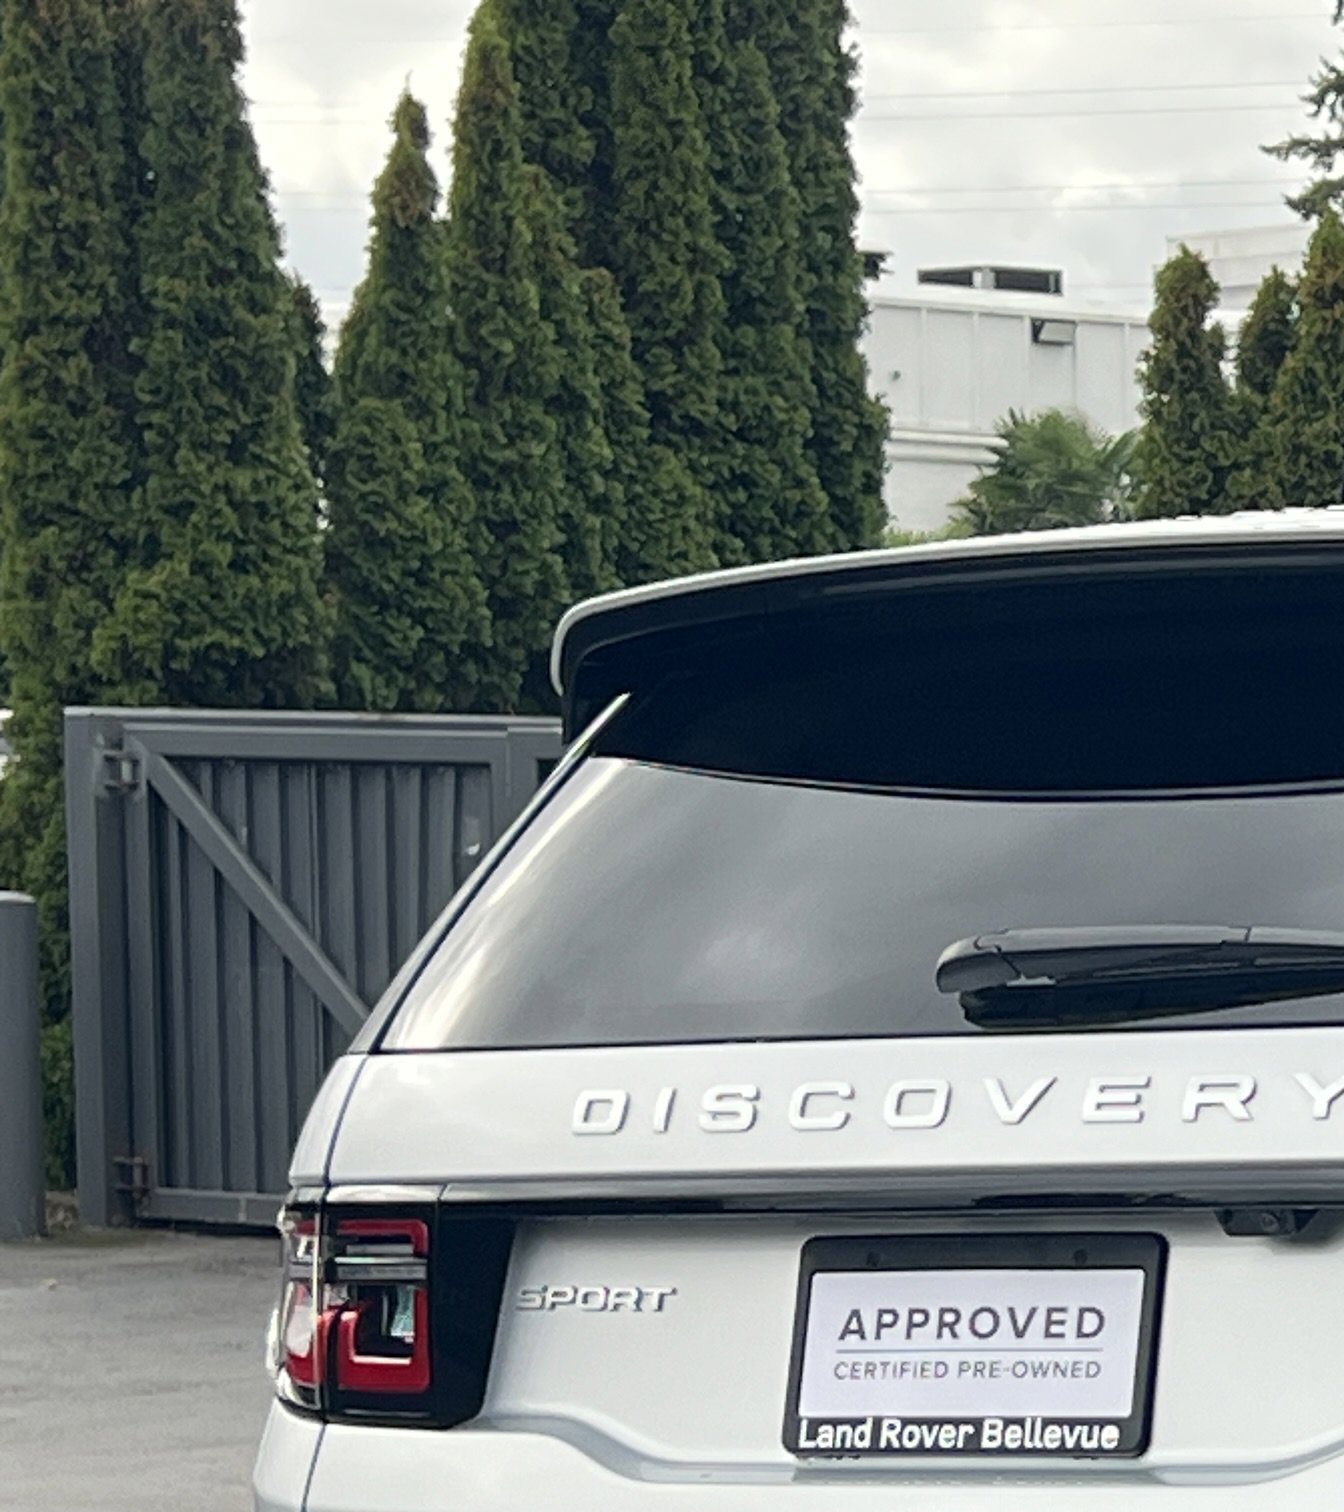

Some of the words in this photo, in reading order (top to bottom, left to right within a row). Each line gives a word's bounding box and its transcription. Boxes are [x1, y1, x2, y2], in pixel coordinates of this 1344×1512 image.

[515, 1284, 679, 1313] SPORT
[838, 1306, 1106, 1341] APPROVED
[833, 1361, 950, 1381] CERTIFIED
[957, 1359, 1102, 1379] PRE-OWNED
[799, 1417, 873, 1449] Land
[879, 1418, 975, 1449] Rover
[980, 1417, 1120, 1449] Bellevue
